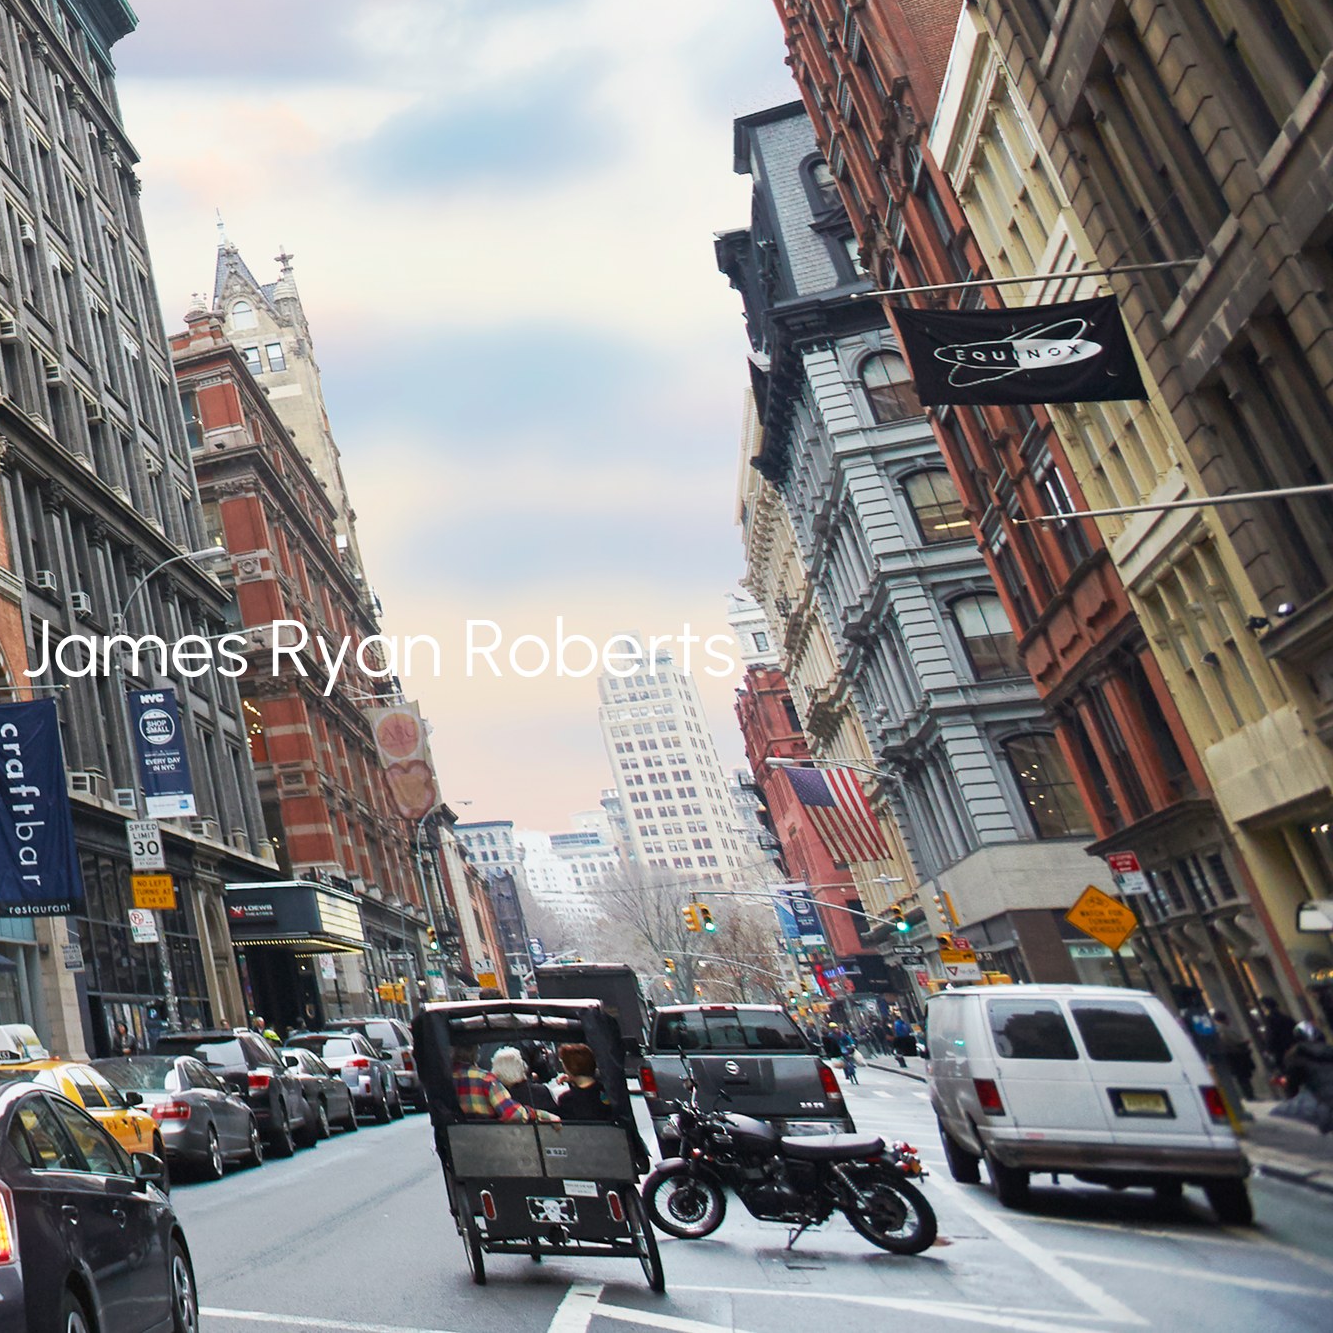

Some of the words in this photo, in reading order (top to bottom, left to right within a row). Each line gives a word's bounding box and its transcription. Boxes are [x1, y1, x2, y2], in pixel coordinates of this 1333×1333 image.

[955, 344, 1081, 362] EQUINOX
[139, 692, 165, 704] NYC
[146, 719, 167, 727] SHOP
[146, 726, 170, 734] SMALL
[145, 757, 166, 765] EVERY
[167, 756, 181, 764] DAY
[0, 722, 46, 887] craftbar
[129, 823, 157, 831] SPEED
[134, 840, 159, 856] 30
[137, 879, 147, 887] NO
[149, 879, 167, 887] LEFT
[135, 887, 159, 895] TURNS
[9, 902, 71, 916] restaurant
[244, 904, 272, 912] LOEWS
